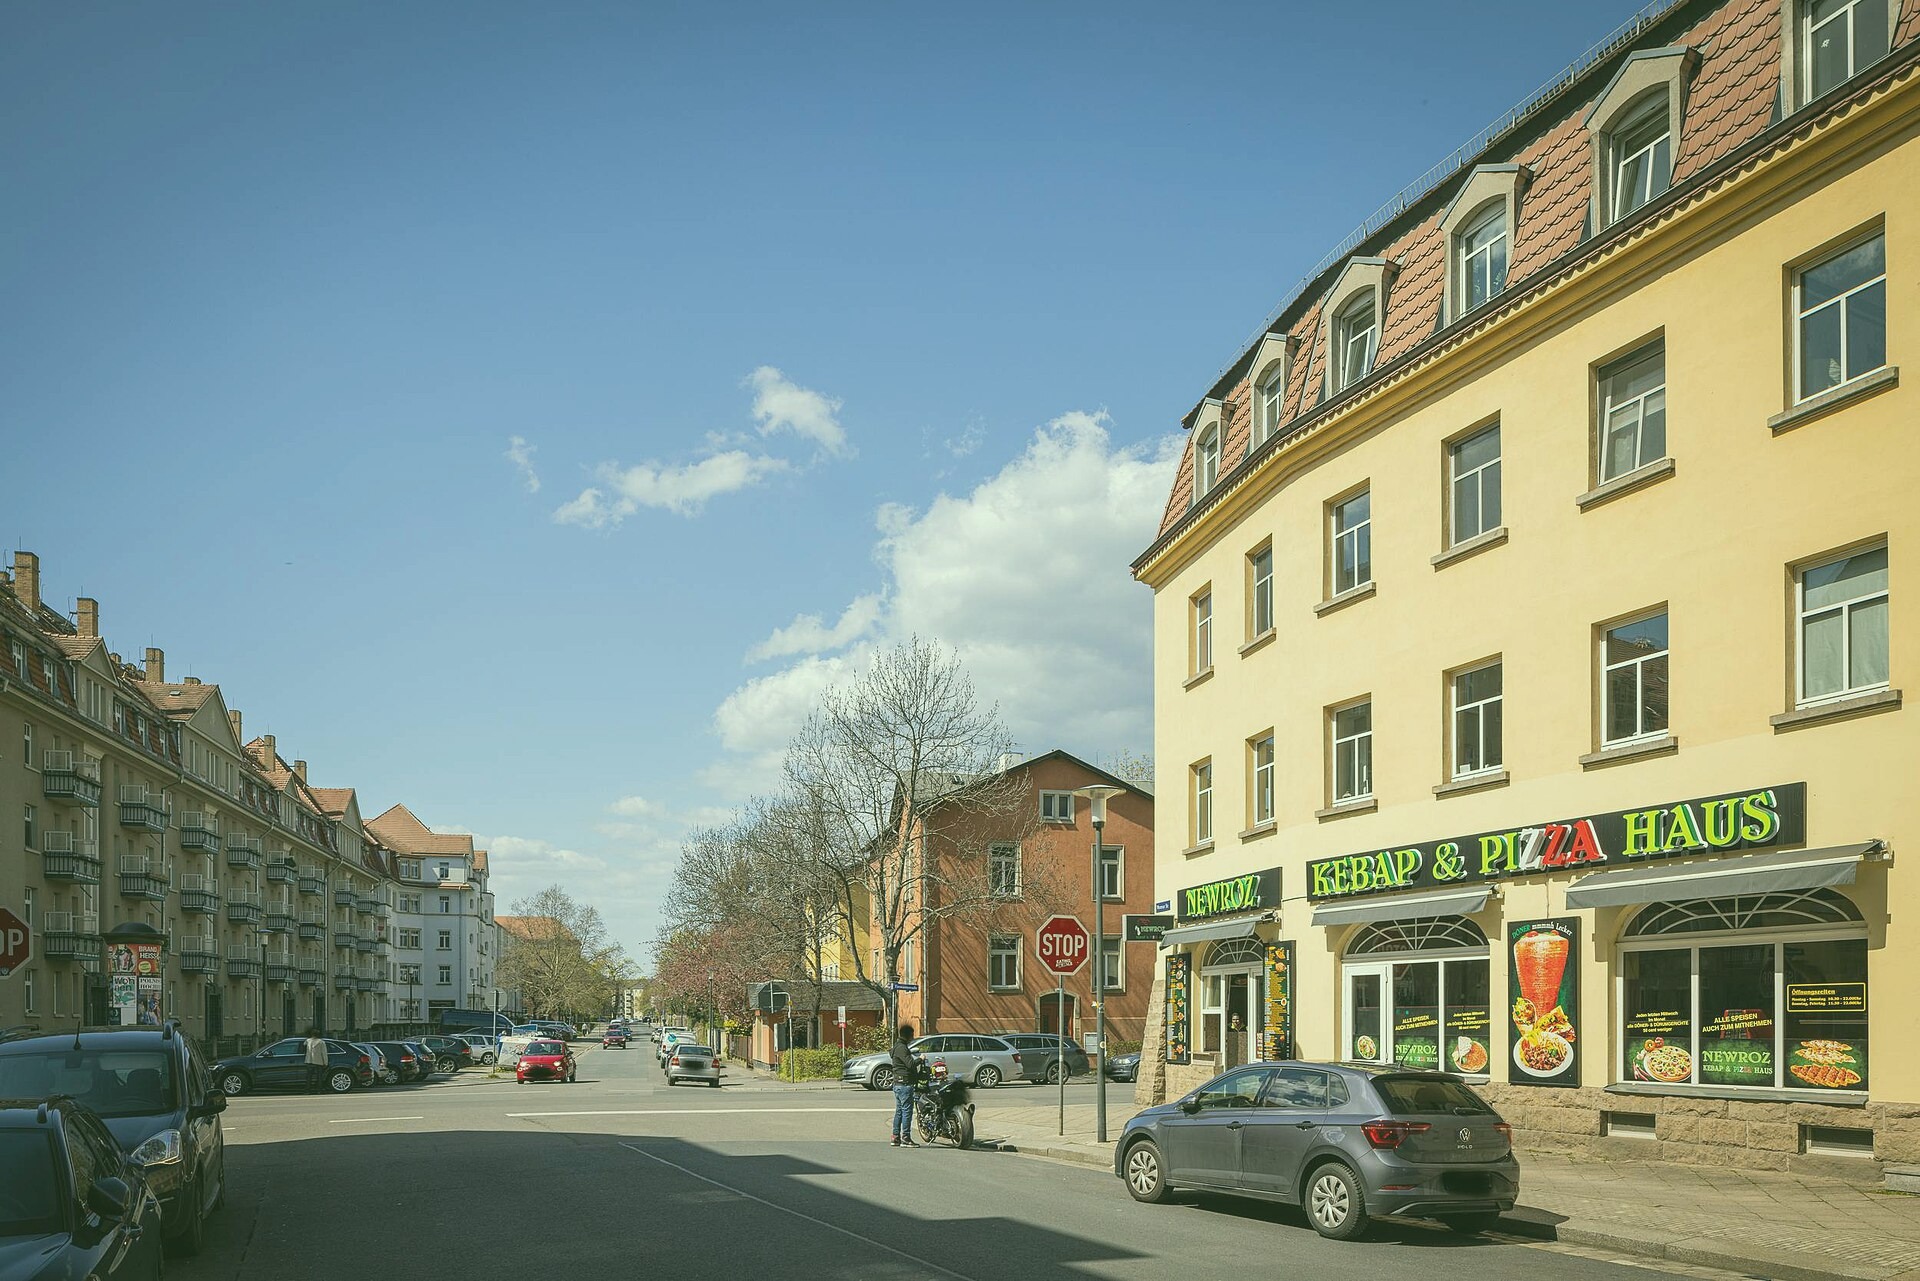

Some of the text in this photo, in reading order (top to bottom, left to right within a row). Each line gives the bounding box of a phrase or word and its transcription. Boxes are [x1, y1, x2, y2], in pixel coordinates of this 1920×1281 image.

[1312, 790, 1780, 896] KEBAP & PIZZA HAUS
[1186, 875, 1260, 917] NEWROZ
[1556, 922, 1573, 936] Lecker
[1042, 933, 1084, 957] STOP
[1730, 1013, 1757, 1021] SPEISEN
[1735, 1019, 1772, 1029] MITNEHMEN
[1395, 1044, 1437, 1055] NEWROZ
[1702, 1051, 1771, 1064] NEWROZ
[1703, 1064, 1723, 1072] KEBAP
